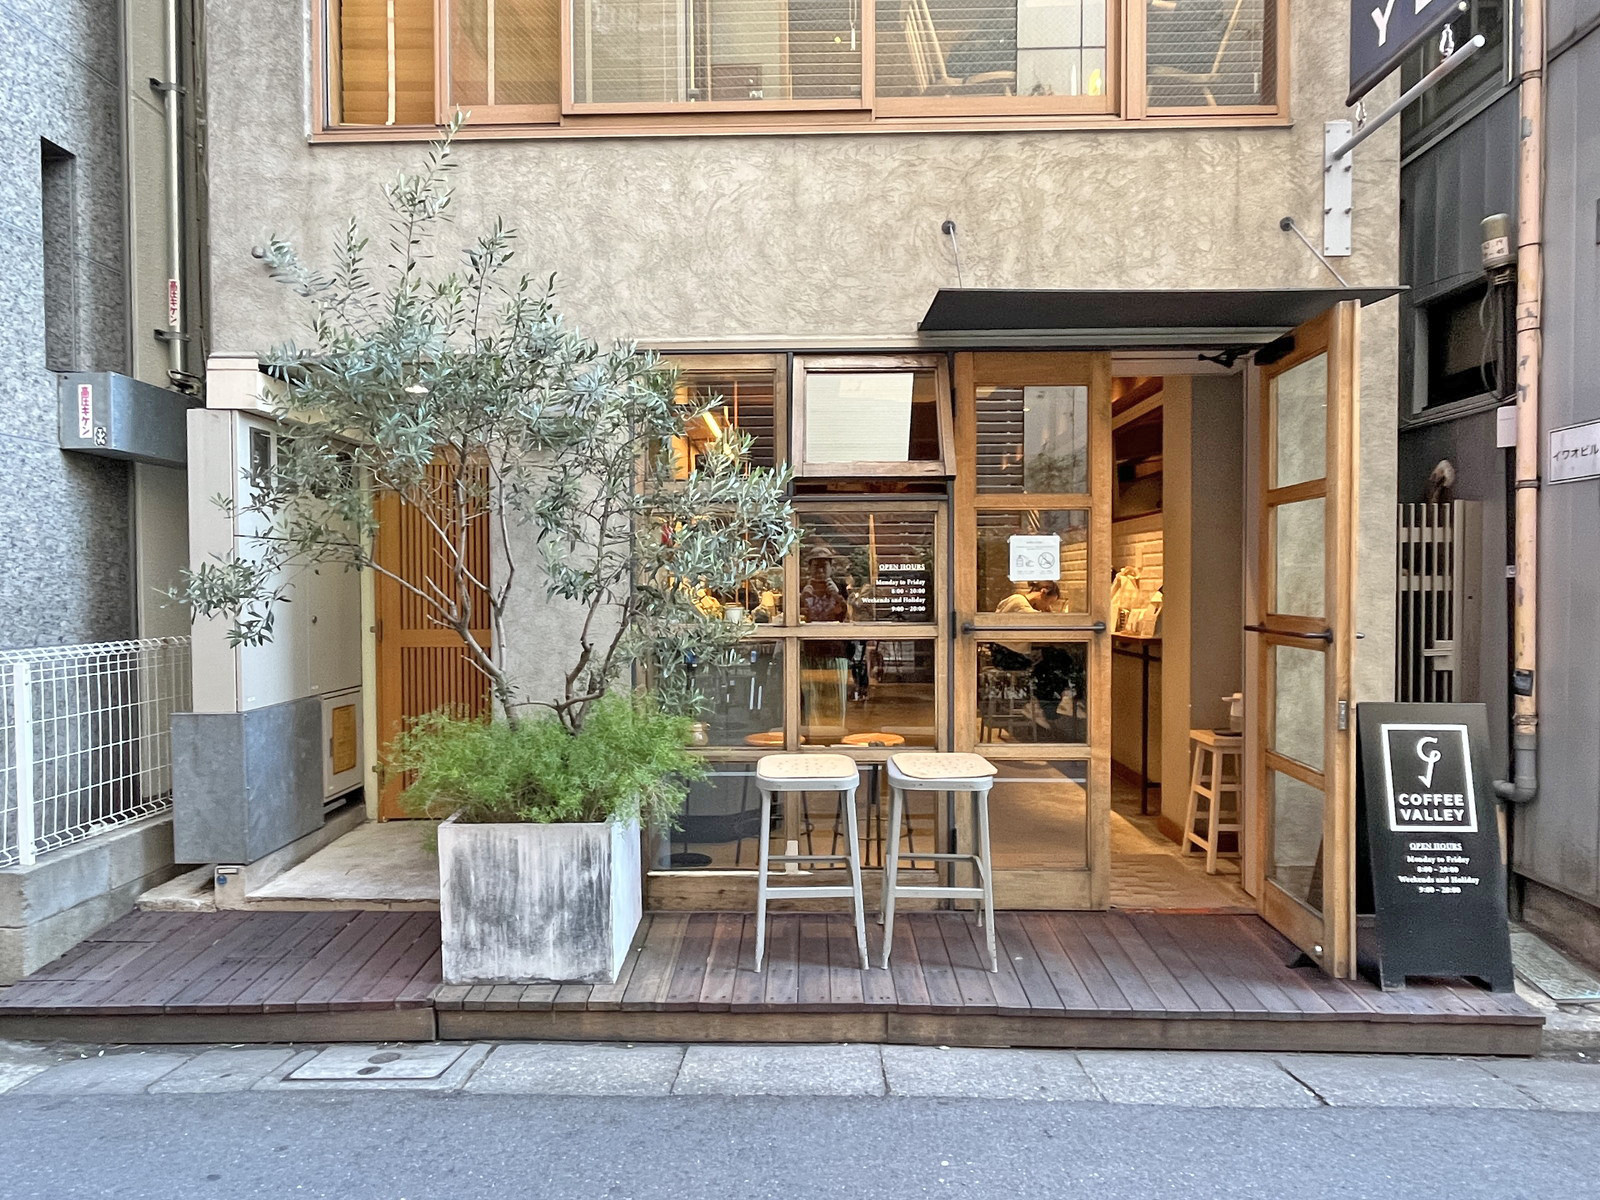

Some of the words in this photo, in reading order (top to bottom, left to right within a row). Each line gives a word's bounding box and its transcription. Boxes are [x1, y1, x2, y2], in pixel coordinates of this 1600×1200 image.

[1553, 444, 1600, 461] イワオビル
[1398, 793, 1464, 806] COFFEE
[1400, 808, 1465, 821] VALLEY
[1409, 842, 1432, 851] OPEN
[1433, 842, 1463, 851] HOURS
[1406, 855, 1436, 864] Monday
[1446, 855, 1470, 864] Friday
[1398, 875, 1434, 883] Weekends
[1450, 876, 1480, 885] Holiday
